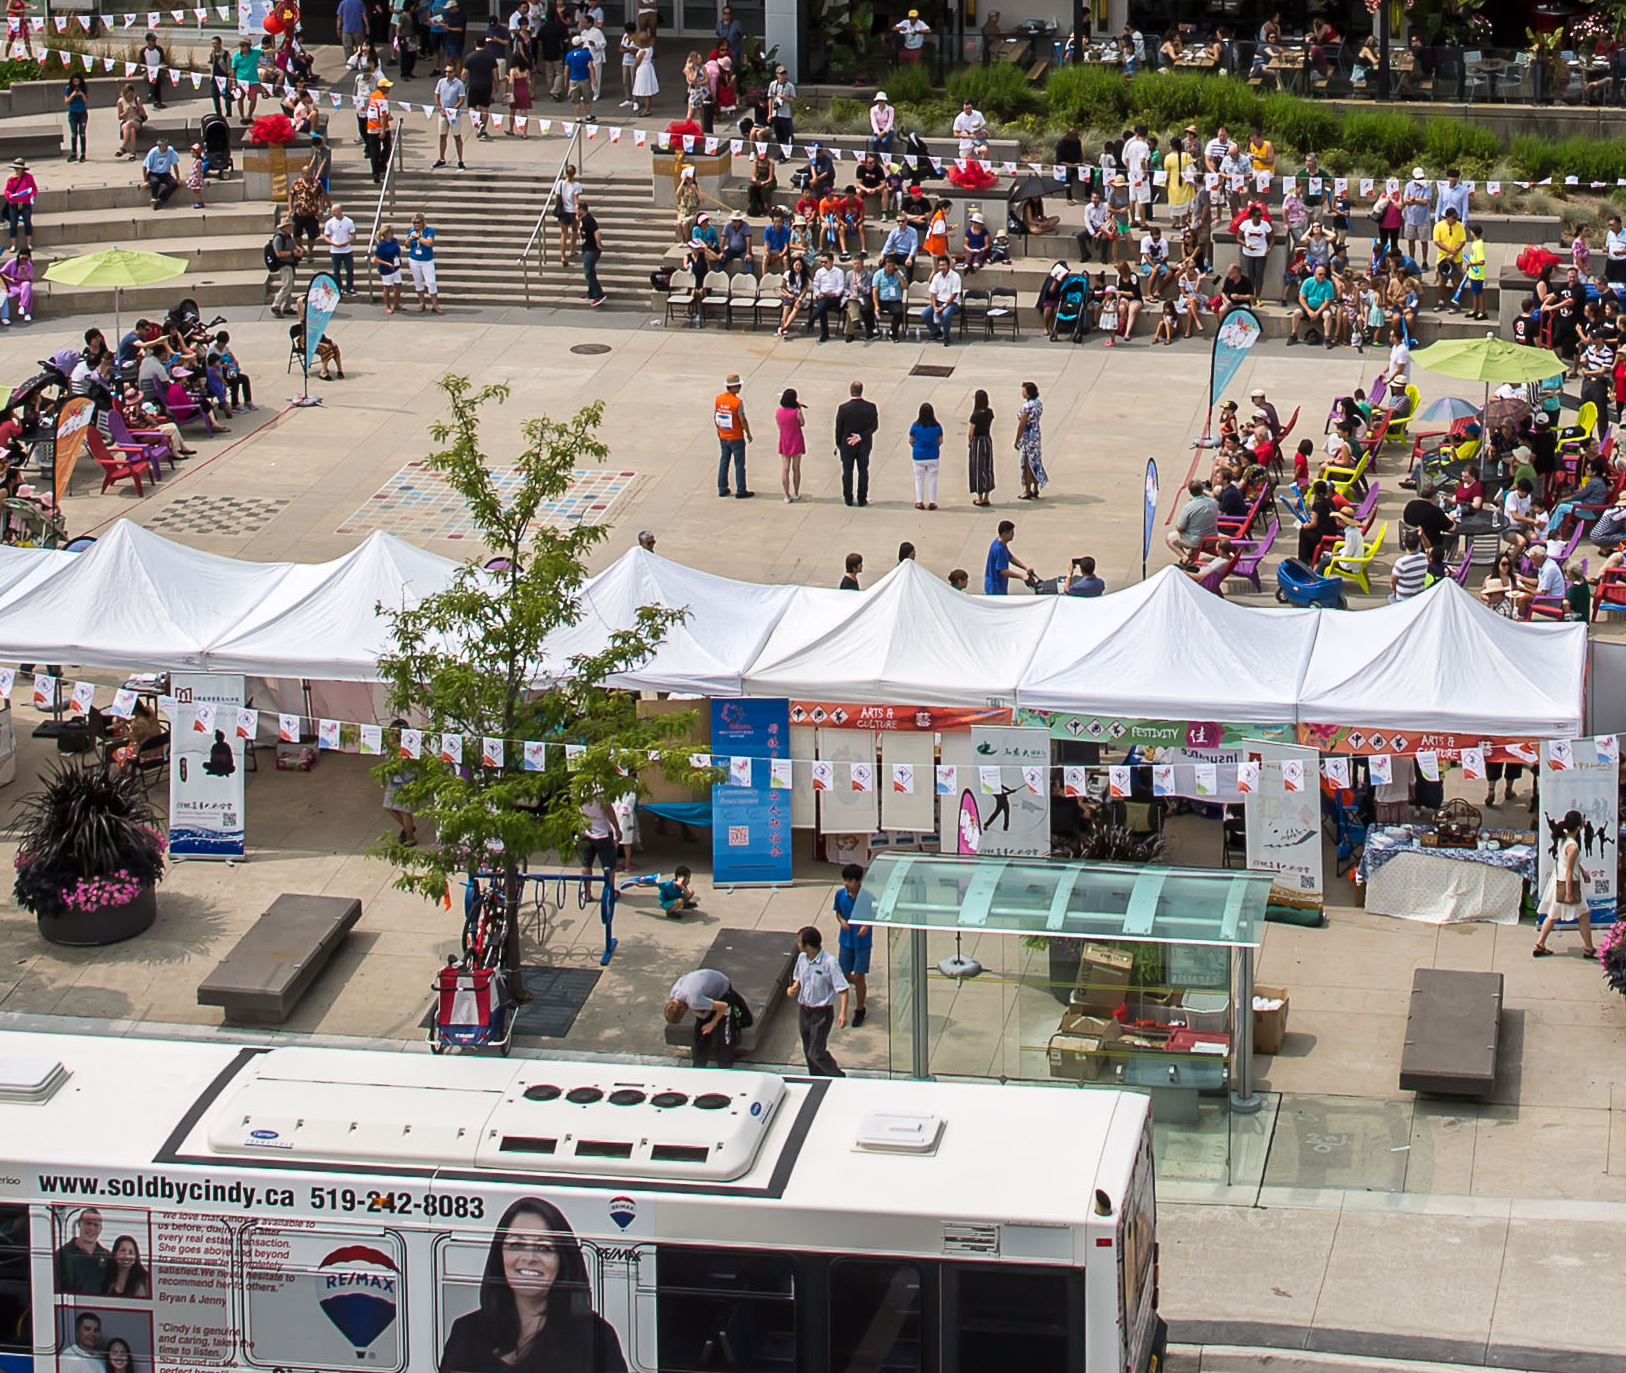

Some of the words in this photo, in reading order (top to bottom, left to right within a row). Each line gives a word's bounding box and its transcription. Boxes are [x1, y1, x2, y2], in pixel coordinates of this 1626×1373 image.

[860, 707, 884, 719] ARTS
[886, 708, 895, 719] &
[856, 719, 898, 729] CULTURE
[1131, 725, 1179, 740] FESTIVITY
[1421, 734, 1444, 746] ARTS
[1447, 735, 1455, 747] &
[38, 1172, 295, 1209] www.soldbycindy.ca
[310, 1186, 485, 1220] 519-242-8083
[171, 1223, 204, 1233] before,
[157, 1233, 183, 1244] every
[185, 1233, 203, 1243] real
[158, 1242, 177, 1253] She
[178, 1245, 202, 1256] goes
[254, 1247, 290, 1260] beyond
[245, 1271, 284, 1282] hesitate
[285, 1274, 296, 1283] to
[325, 1272, 395, 1293] RE/MAX
[157, 1278, 214, 1289] recommend
[158, 1291, 187, 1304] Bryan
[188, 1294, 196, 1303] &
[198, 1294, 227, 1307] Jenny
[192, 1325, 201, 1334] is
[158, 1335, 176, 1344] and
[158, 1346, 179, 1355] time
[181, 1347, 191, 1356] to
[192, 1347, 222, 1357] listen.
